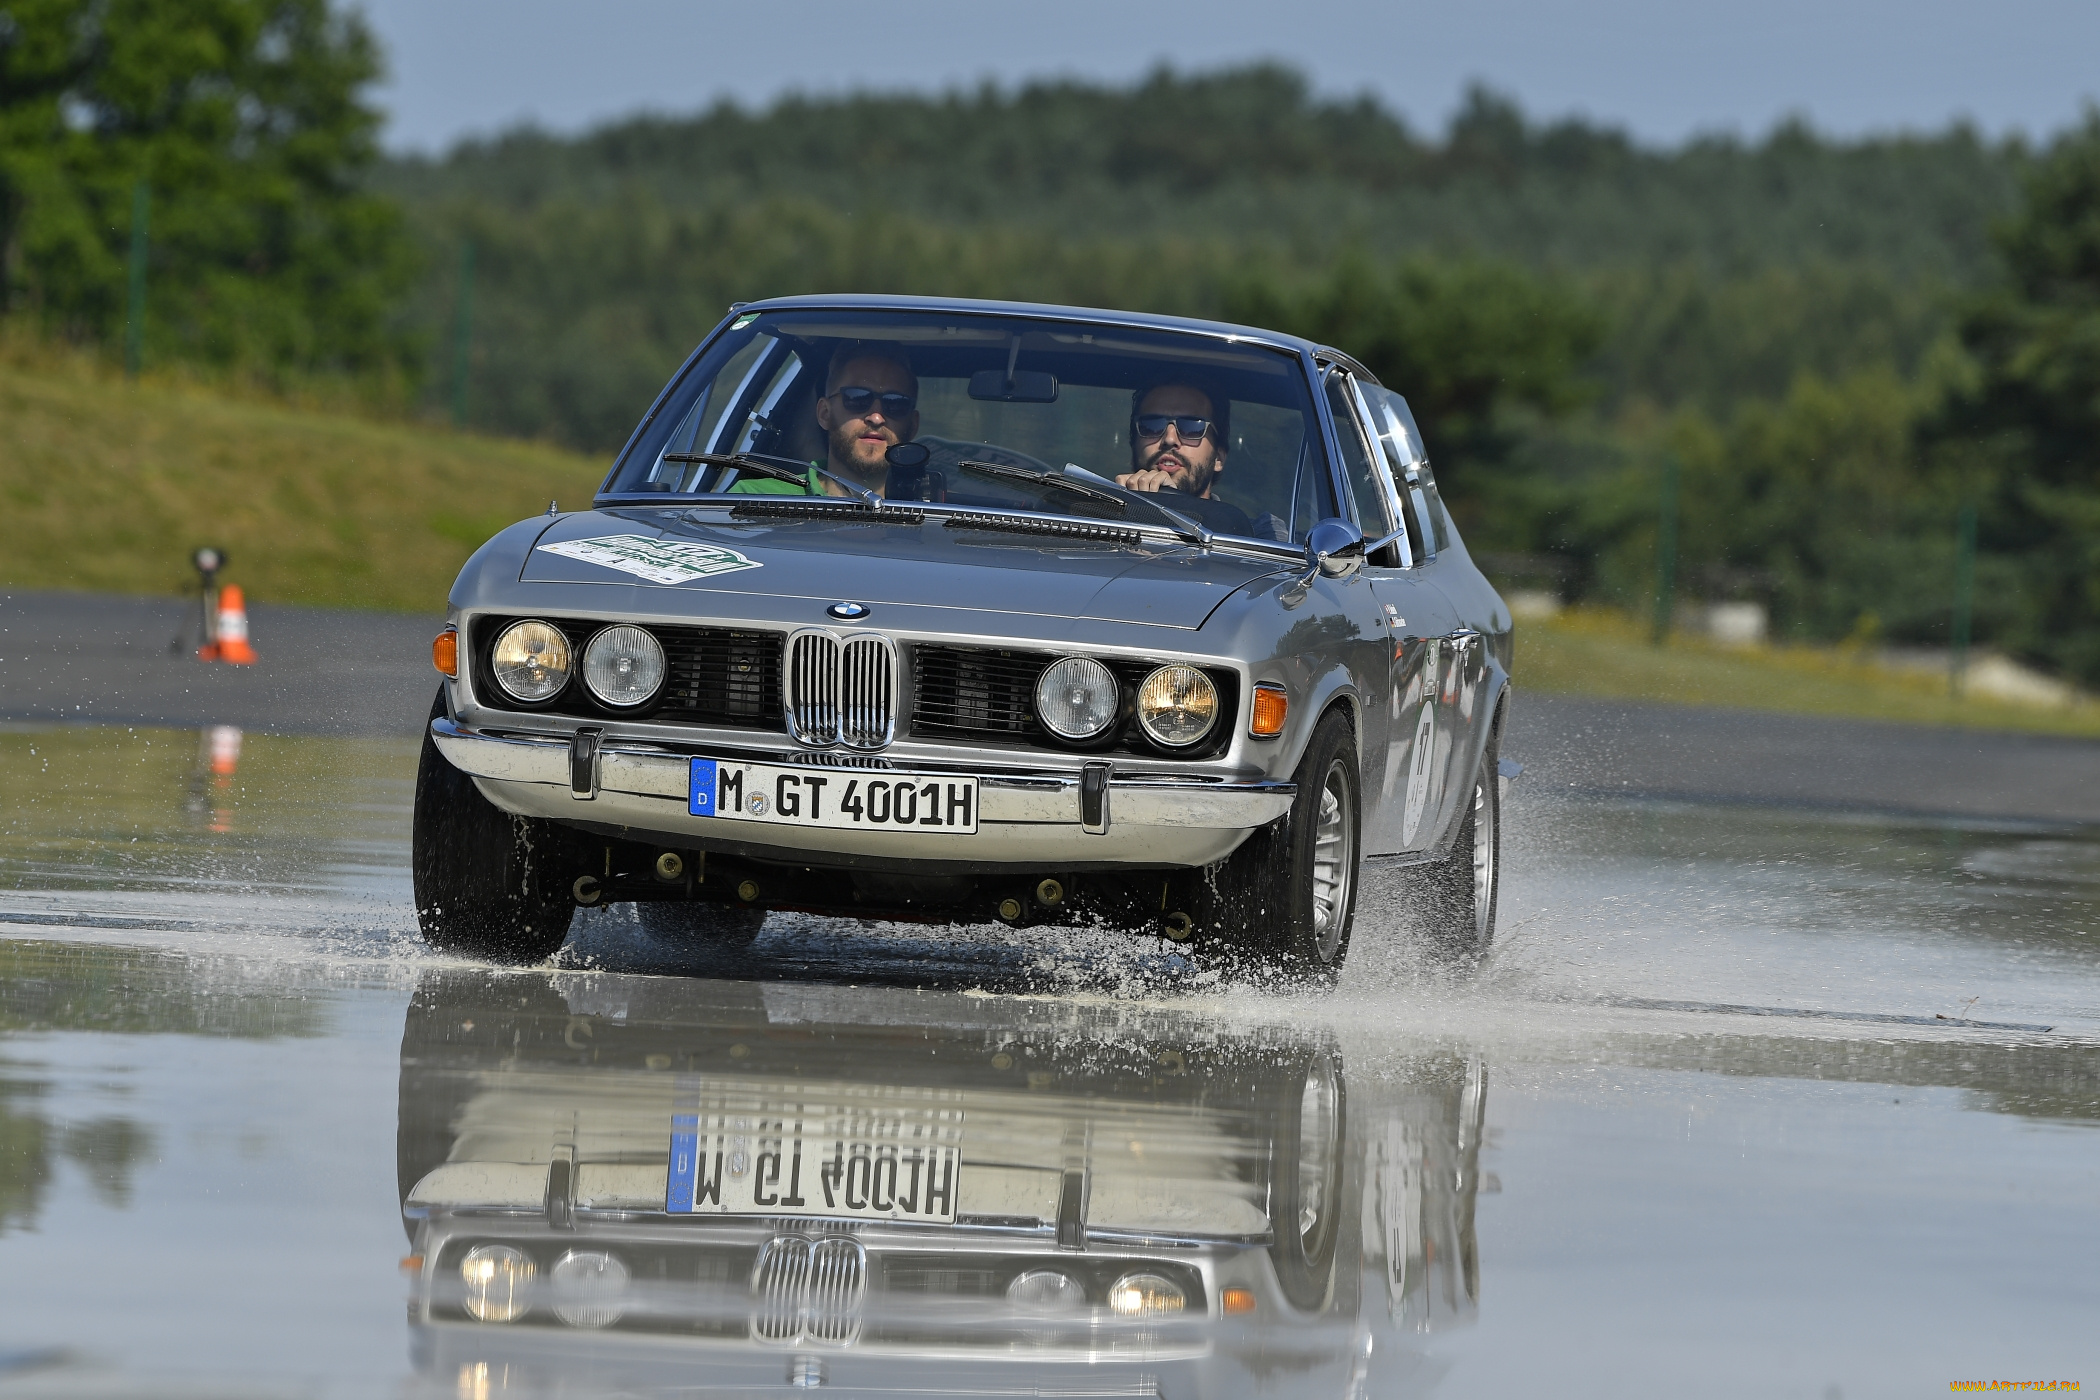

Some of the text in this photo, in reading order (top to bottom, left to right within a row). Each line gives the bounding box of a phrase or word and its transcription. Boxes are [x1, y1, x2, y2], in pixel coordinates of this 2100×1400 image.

[1416, 722, 1431, 775] 17
[697, 792, 708, 805] D
[718, 767, 743, 812] M
[776, 774, 828, 819] GT
[840, 779, 972, 826] 4001H
